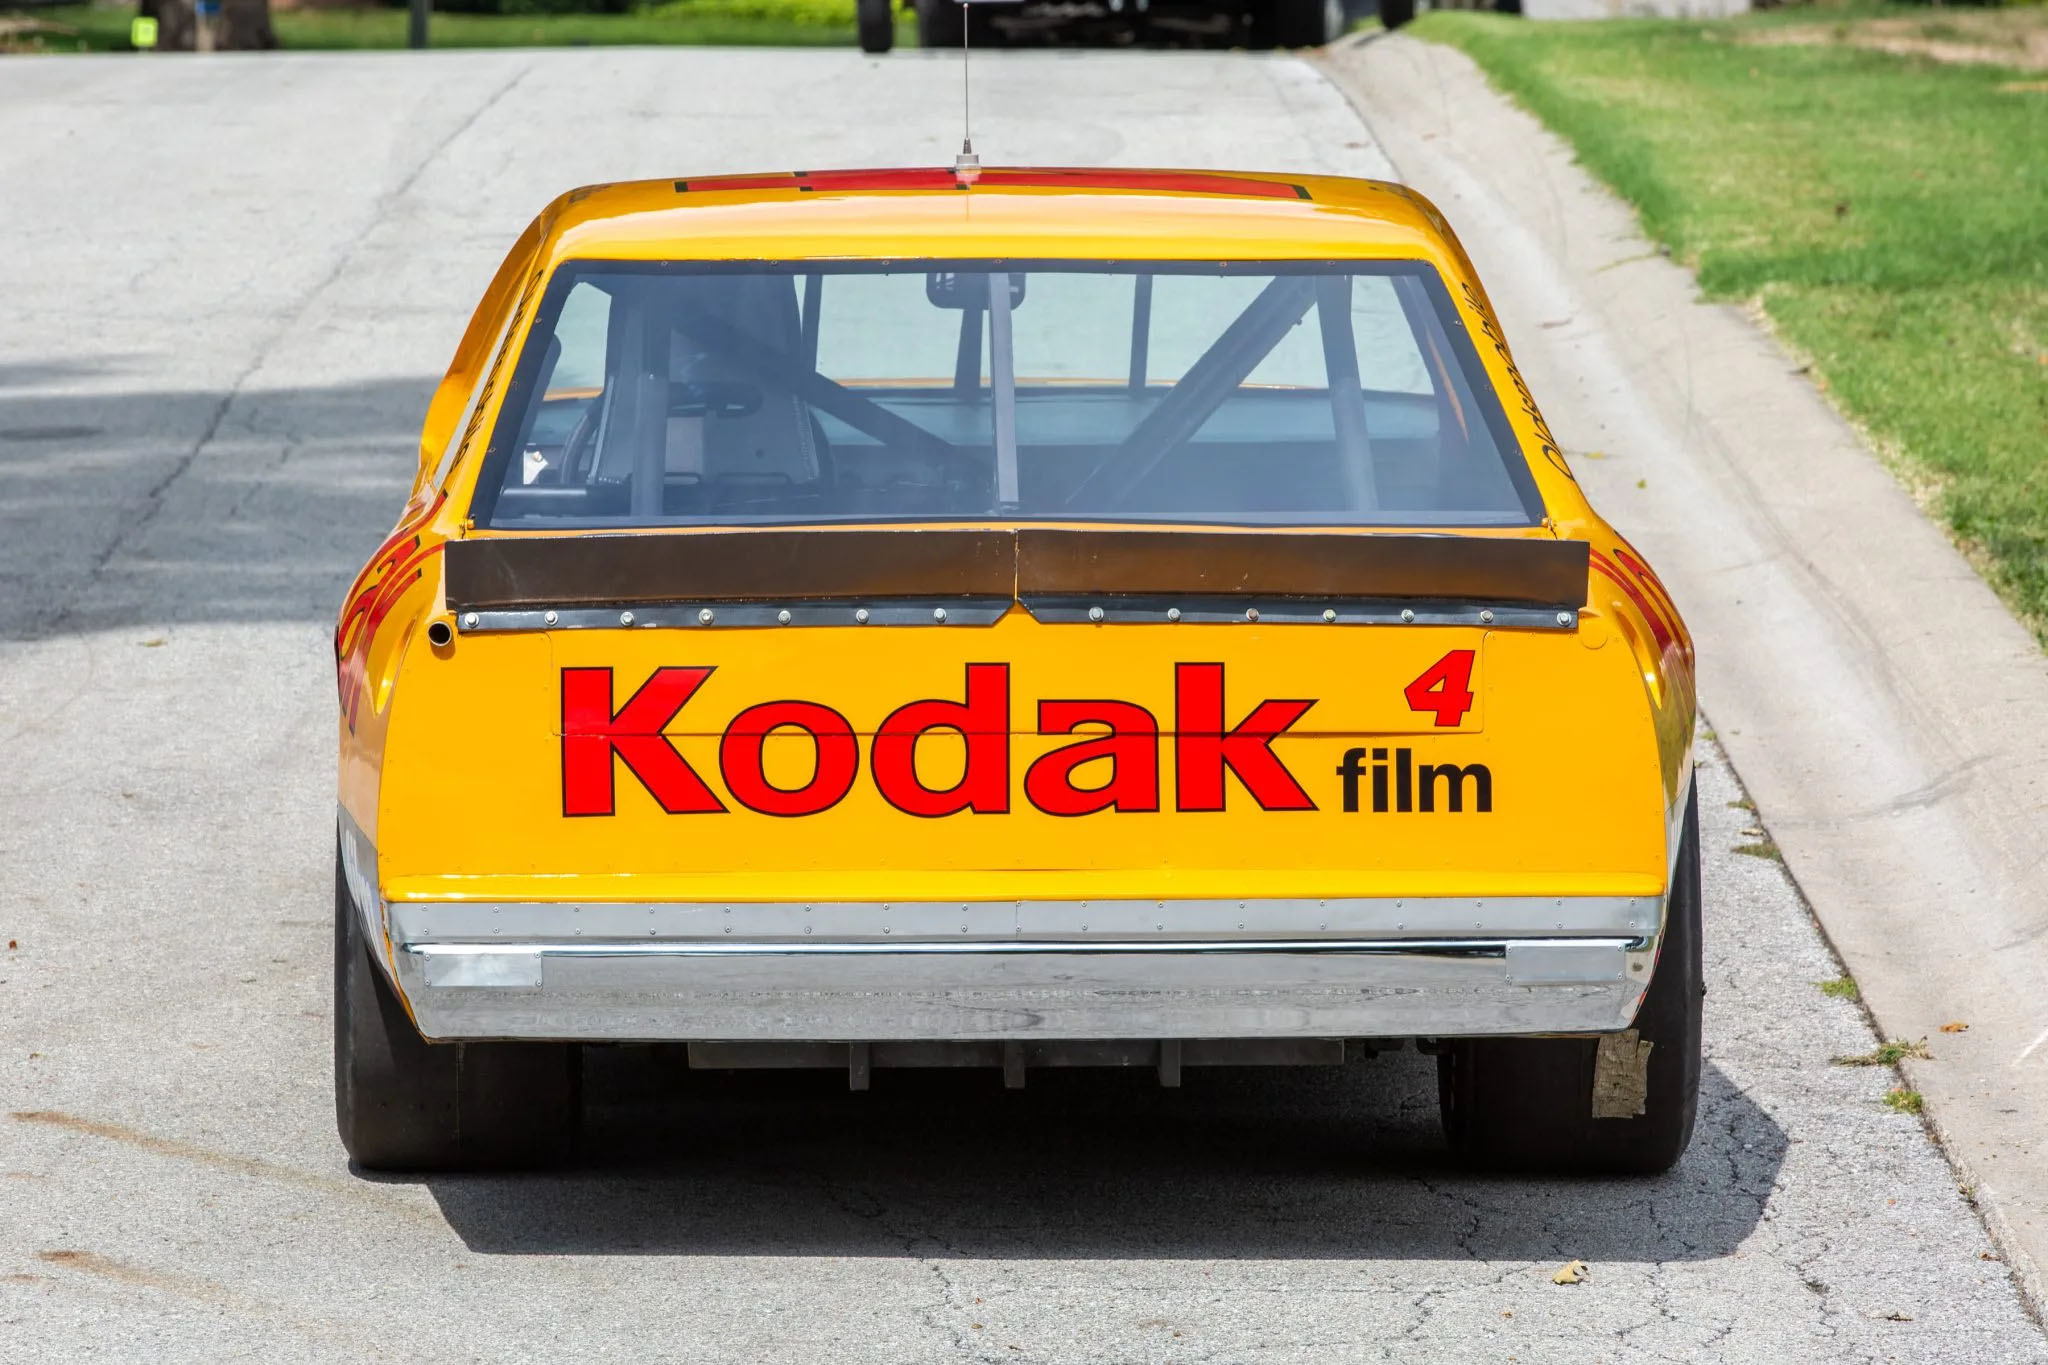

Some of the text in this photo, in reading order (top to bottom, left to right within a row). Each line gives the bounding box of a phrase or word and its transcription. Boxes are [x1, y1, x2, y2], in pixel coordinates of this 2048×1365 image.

[560, 662, 1492, 818] Kodak film
[1404, 649, 1476, 727] 4
